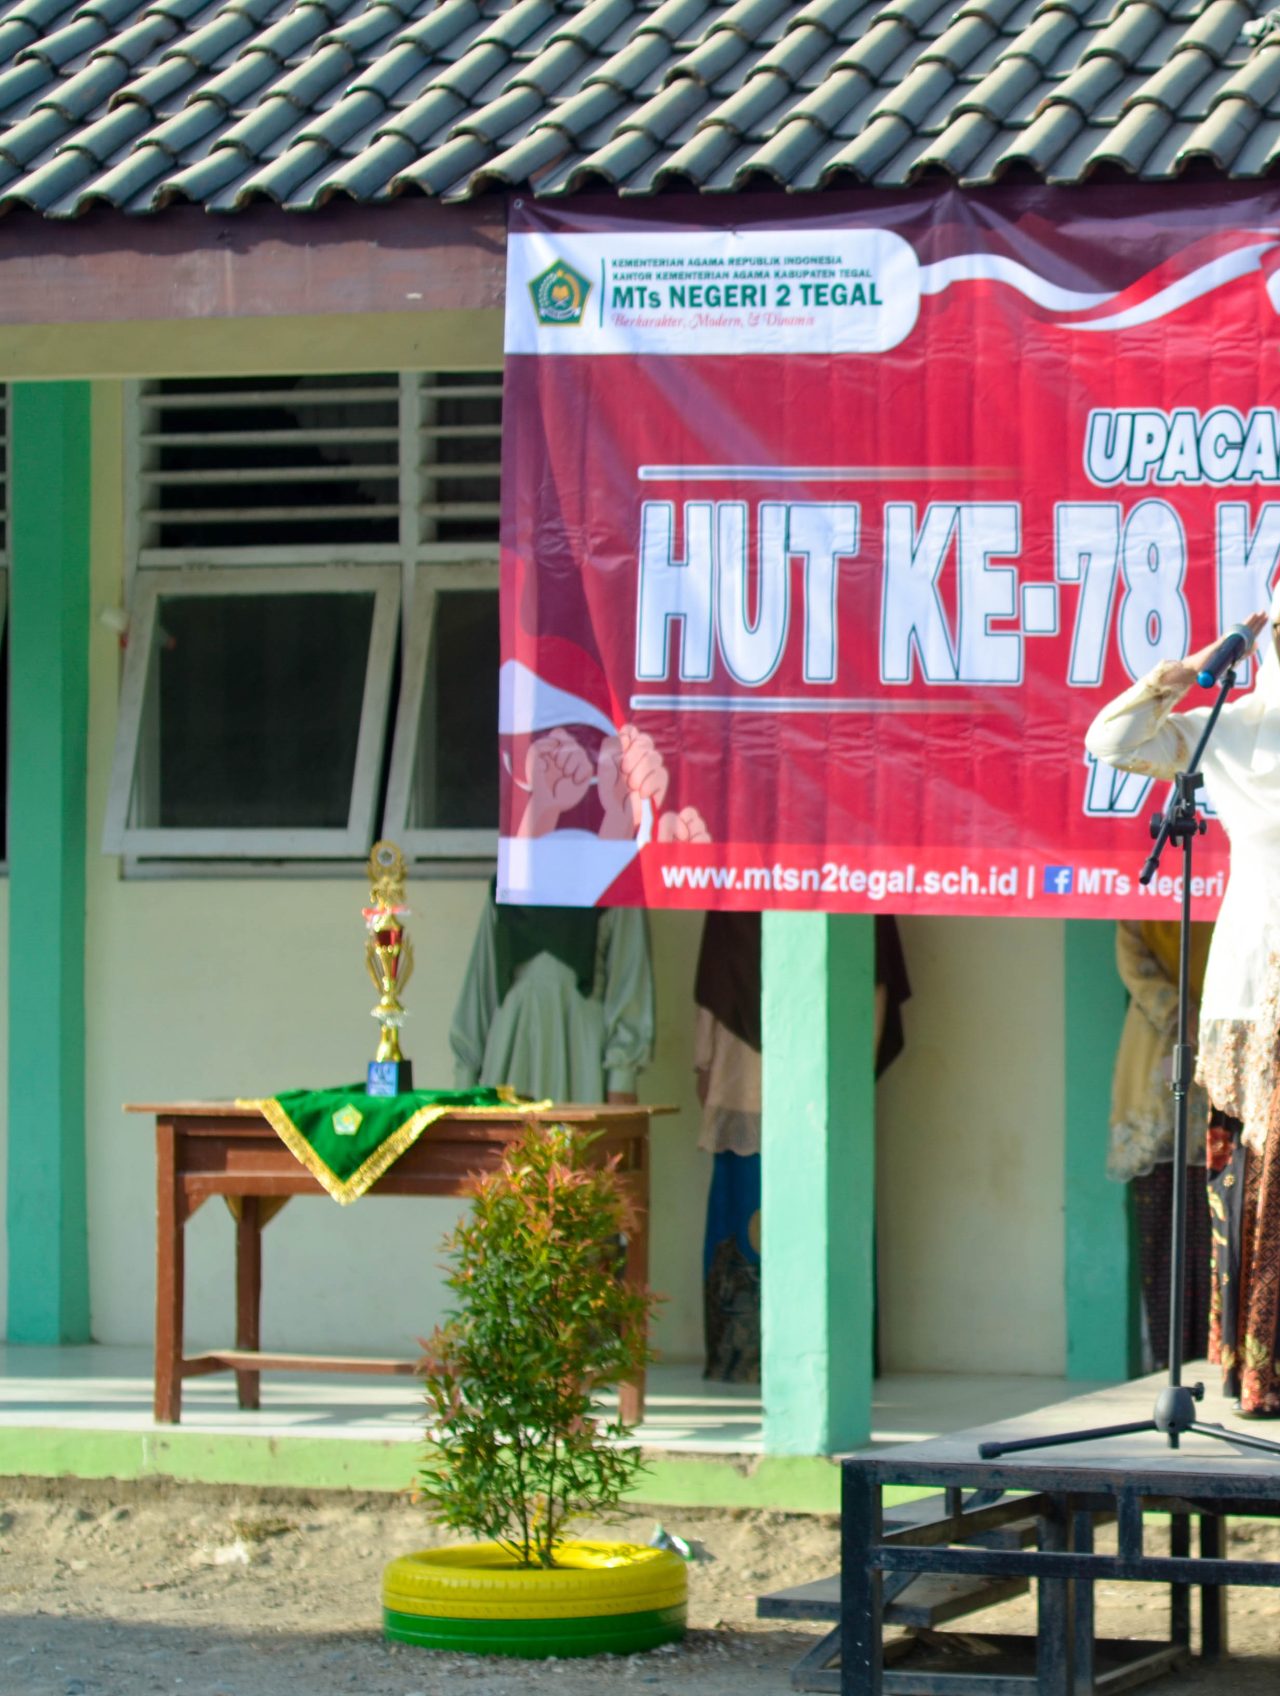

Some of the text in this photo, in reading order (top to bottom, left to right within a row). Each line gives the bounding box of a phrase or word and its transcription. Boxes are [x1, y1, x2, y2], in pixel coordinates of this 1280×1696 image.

[612, 256, 842, 267] KEMENTERIAN AGAMA REPUBLIK INDONESIA
[613, 269, 872, 281] KANTOR KEMENTERIAN AGAMA KABUPATEN TEGAL
[612, 282, 883, 308] MTs NEGERI 2 TEGAL
[636, 500, 860, 687] HUT
[880, 497, 1190, 688] KE-78
[661, 863, 1017, 900] www.mtsn2tegal.sch.id
[1077, 868, 1131, 895] MTs
